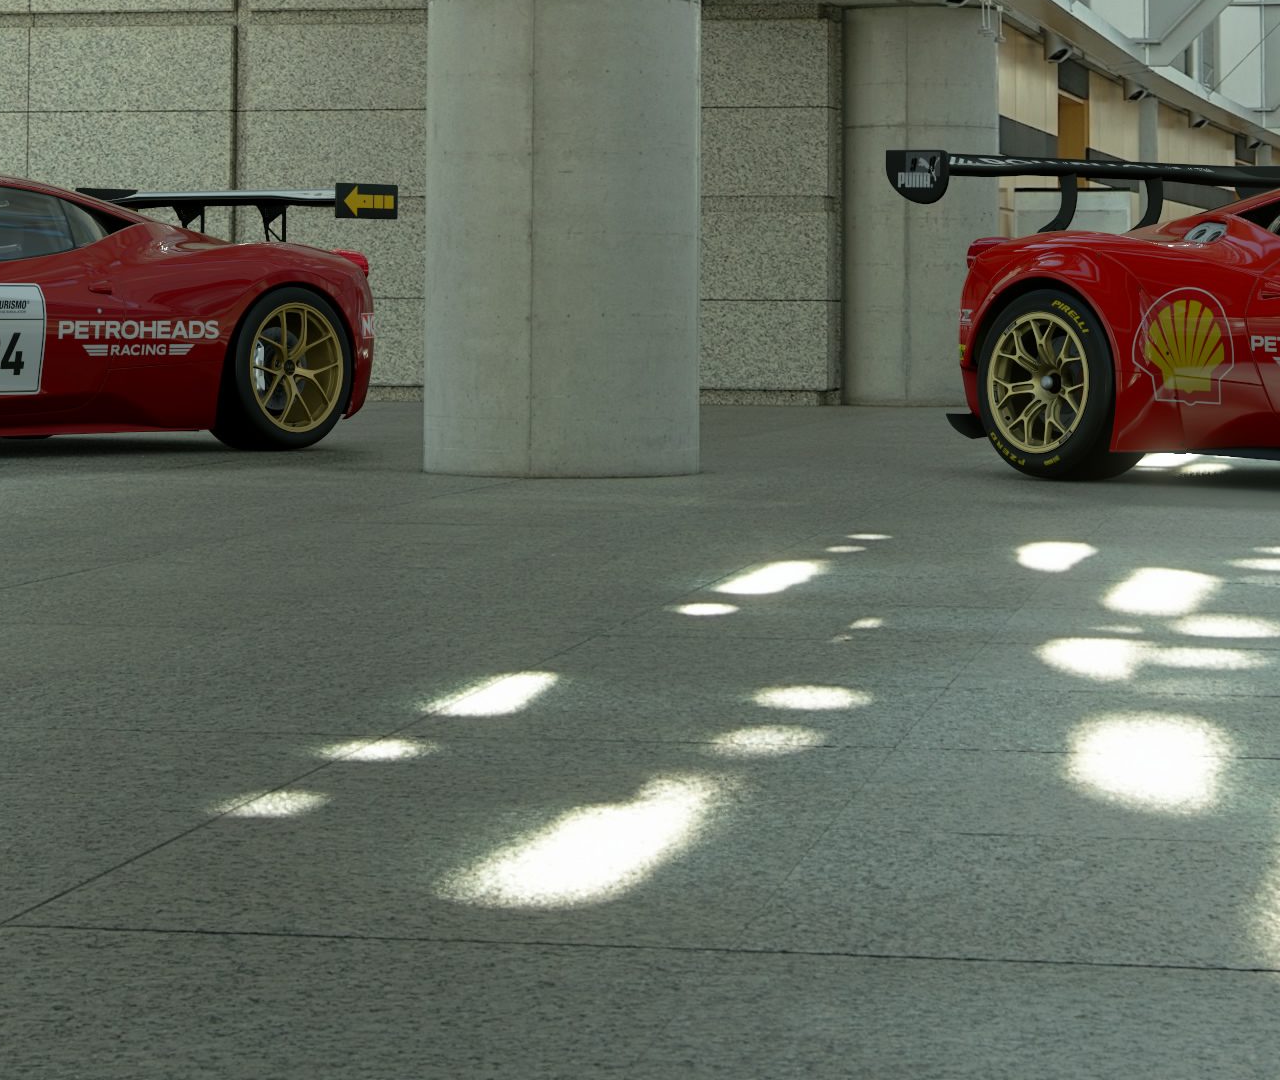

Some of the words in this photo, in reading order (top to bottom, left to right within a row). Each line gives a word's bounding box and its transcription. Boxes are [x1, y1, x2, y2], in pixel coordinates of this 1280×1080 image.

[1052, 300, 1090, 333] PIRELLI
[58, 320, 219, 340] PETROHEADS
[110, 344, 166, 356] RACING
